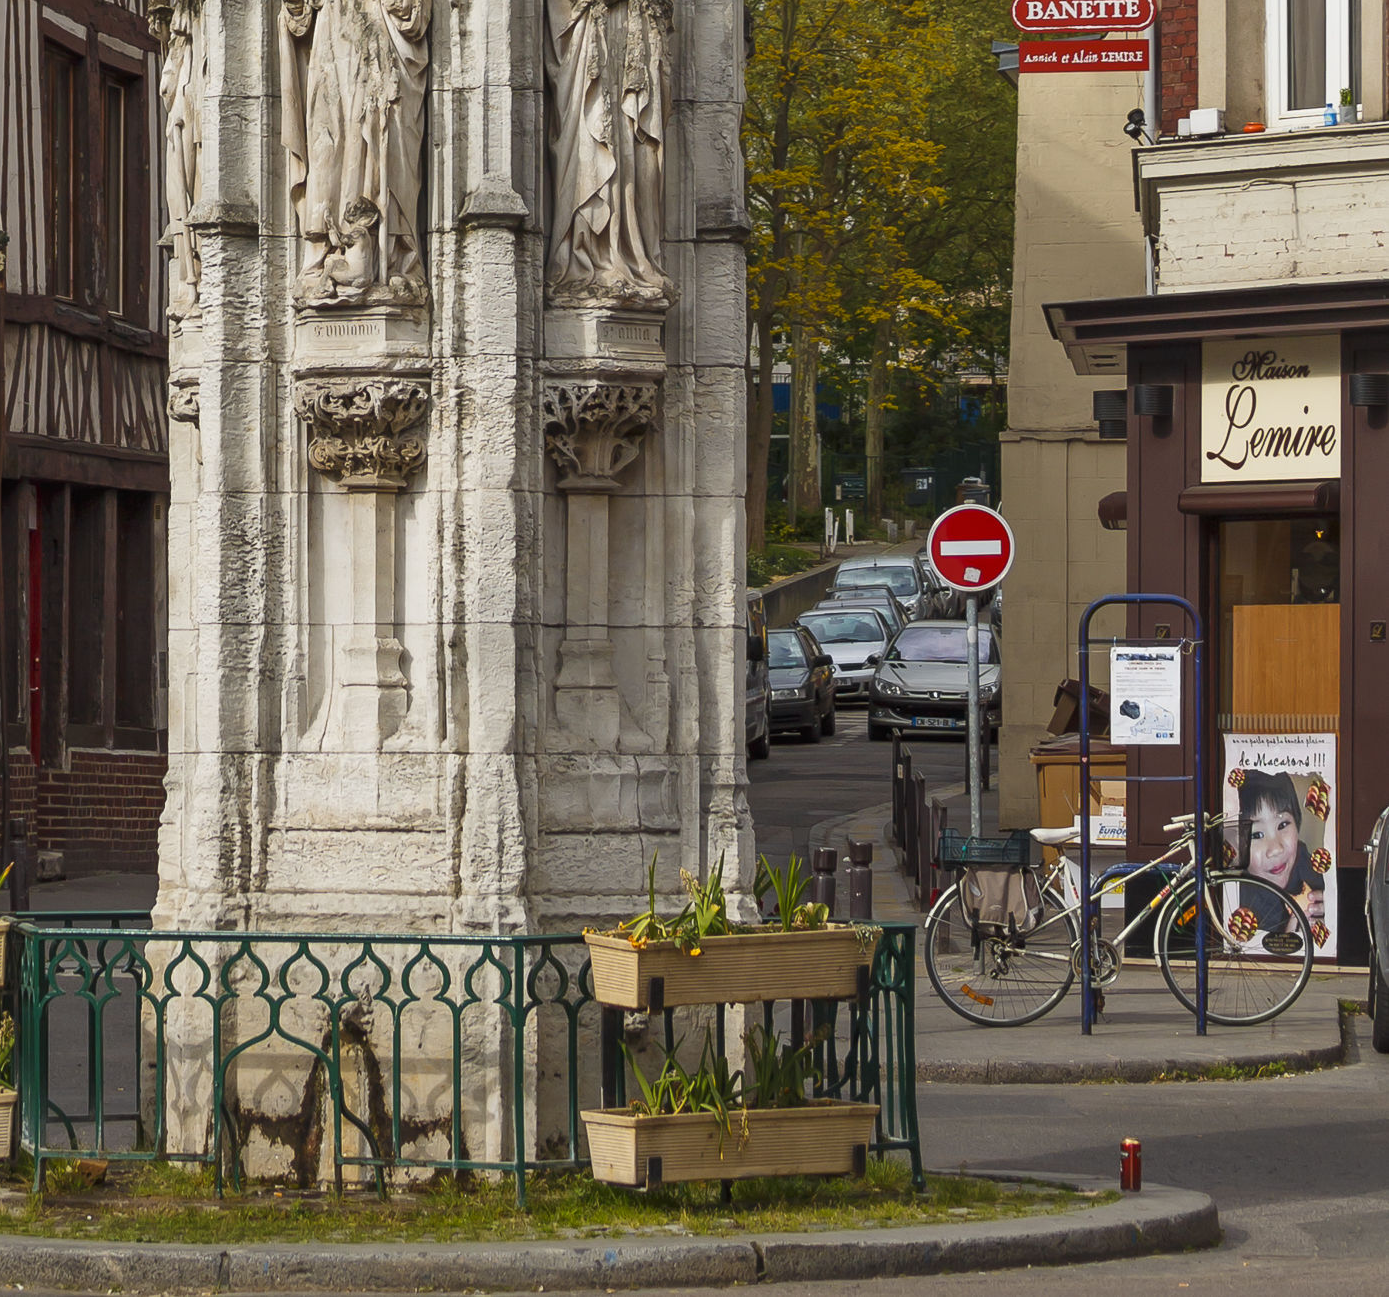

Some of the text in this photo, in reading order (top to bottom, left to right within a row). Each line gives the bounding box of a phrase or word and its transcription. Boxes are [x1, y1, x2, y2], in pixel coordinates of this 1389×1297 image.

[1026, 0, 1140, 19] BANETTE
[1024, 49, 1143, 63] Annick et Alain LEMIRE
[1232, 350, 1311, 381] Maison
[1206, 384, 1336, 470] Lemire
[1249, 736, 1264, 747] parle
[1305, 735, 1325, 747] pleine
[1239, 750, 1251, 767] de
[1253, 752, 1309, 767] Macarons
